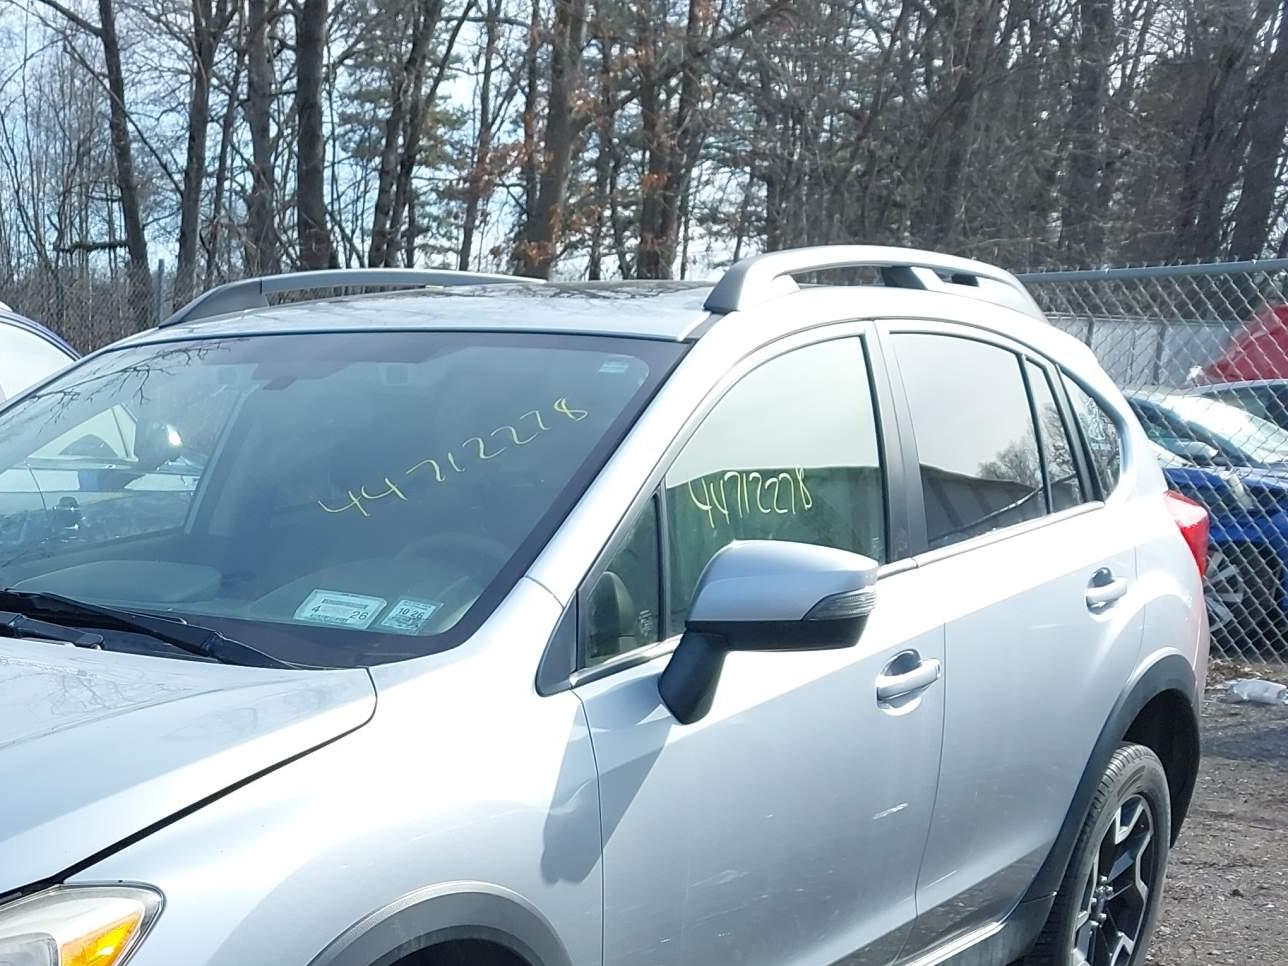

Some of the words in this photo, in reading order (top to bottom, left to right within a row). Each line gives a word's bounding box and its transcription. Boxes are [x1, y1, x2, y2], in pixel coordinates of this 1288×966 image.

[318, 397, 589, 517] 44712278
[688, 464, 813, 529] 44712278
[350, 610, 369, 620] 26
[399, 607, 410, 615] 10
[411, 610, 424, 619] 26
